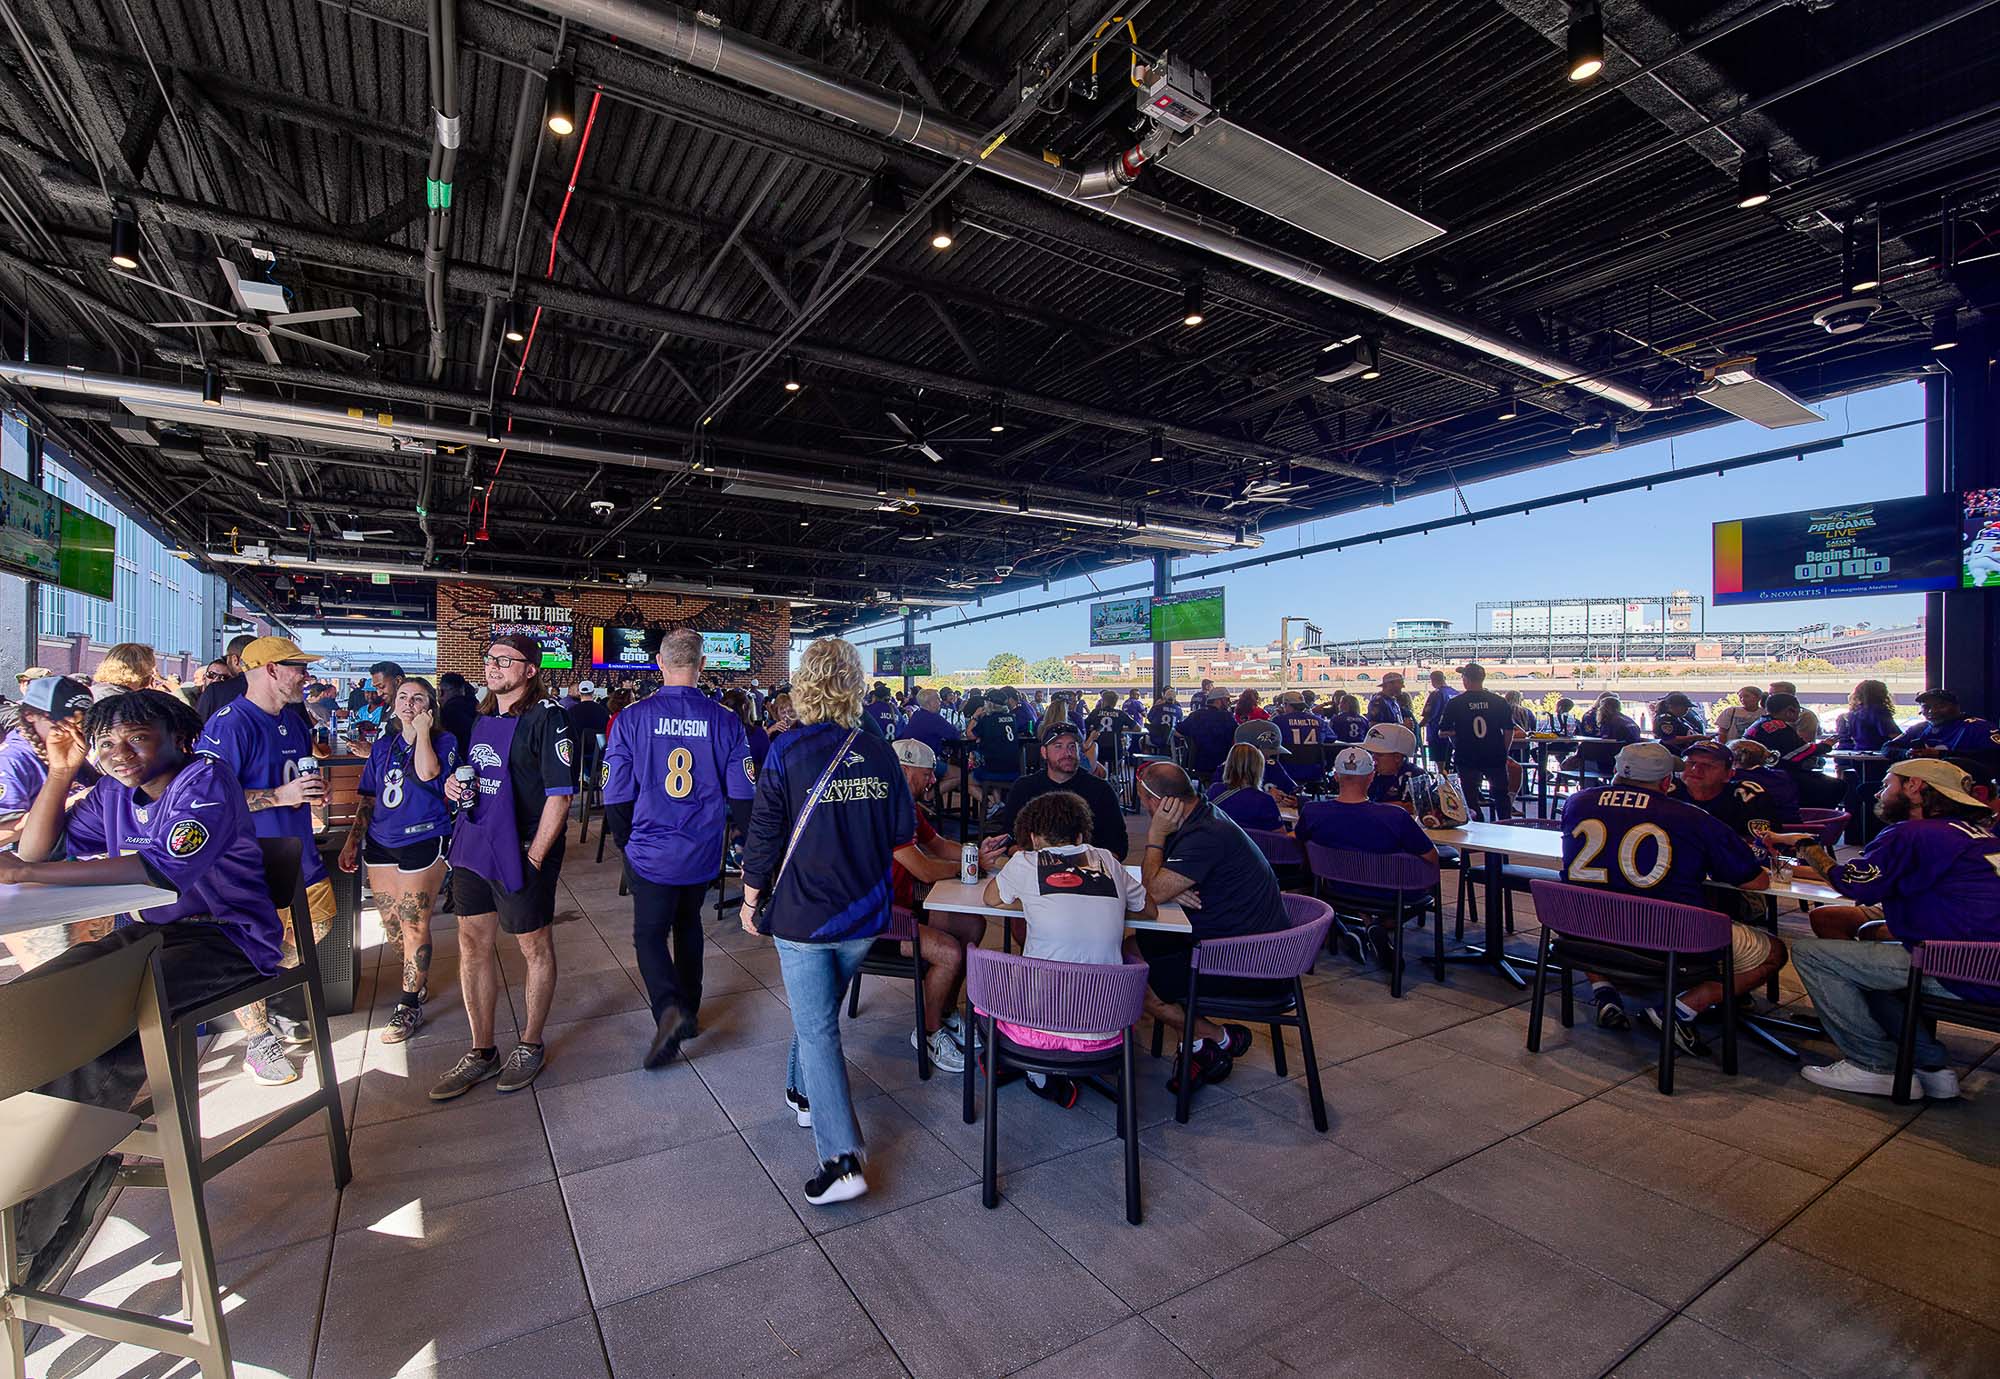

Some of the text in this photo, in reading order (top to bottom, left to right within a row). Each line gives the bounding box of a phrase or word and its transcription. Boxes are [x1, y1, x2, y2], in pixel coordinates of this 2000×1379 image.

[1807, 518, 1877, 532] PREGAME
[1825, 528, 1857, 538] LIVE
[1806, 549, 1851, 562] Begins
[1770, 588, 1821, 598] NOVARTIS
[491, 603, 573, 623] TIME TO RISE
[1468, 701, 1489, 710] SMITH
[654, 717, 708, 737] JACKSON
[885, 723, 896, 740] 8
[1005, 725, 1015, 741] 8
[1473, 715, 1487, 738] 0
[1291, 728, 1319, 745] 14
[665, 747, 693, 799] 8
[1598, 790, 1650, 809] REED
[1567, 818, 1673, 889] 20
